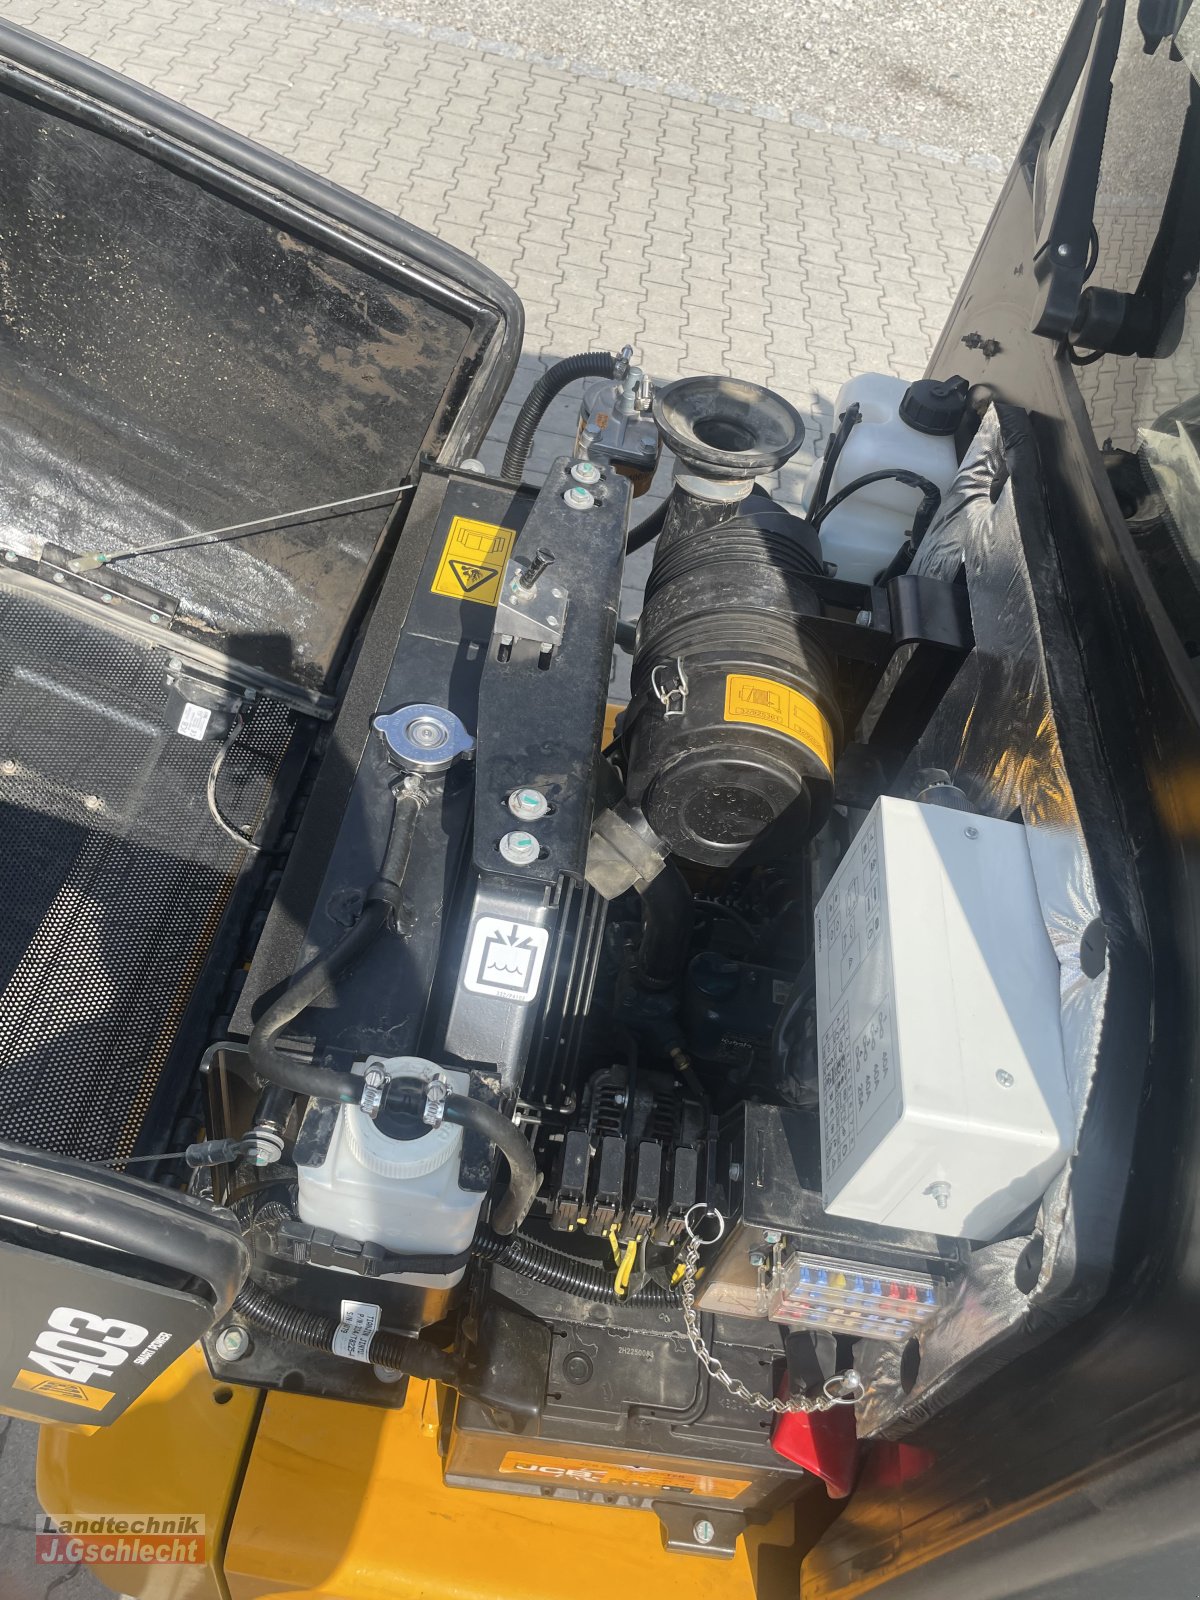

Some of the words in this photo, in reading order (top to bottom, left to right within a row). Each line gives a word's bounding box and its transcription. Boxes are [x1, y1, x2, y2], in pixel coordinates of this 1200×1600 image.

[28, 1306, 149, 1383] 403
[133, 1348, 156, 1365] SMART
[147, 1331, 172, 1350] POWER
